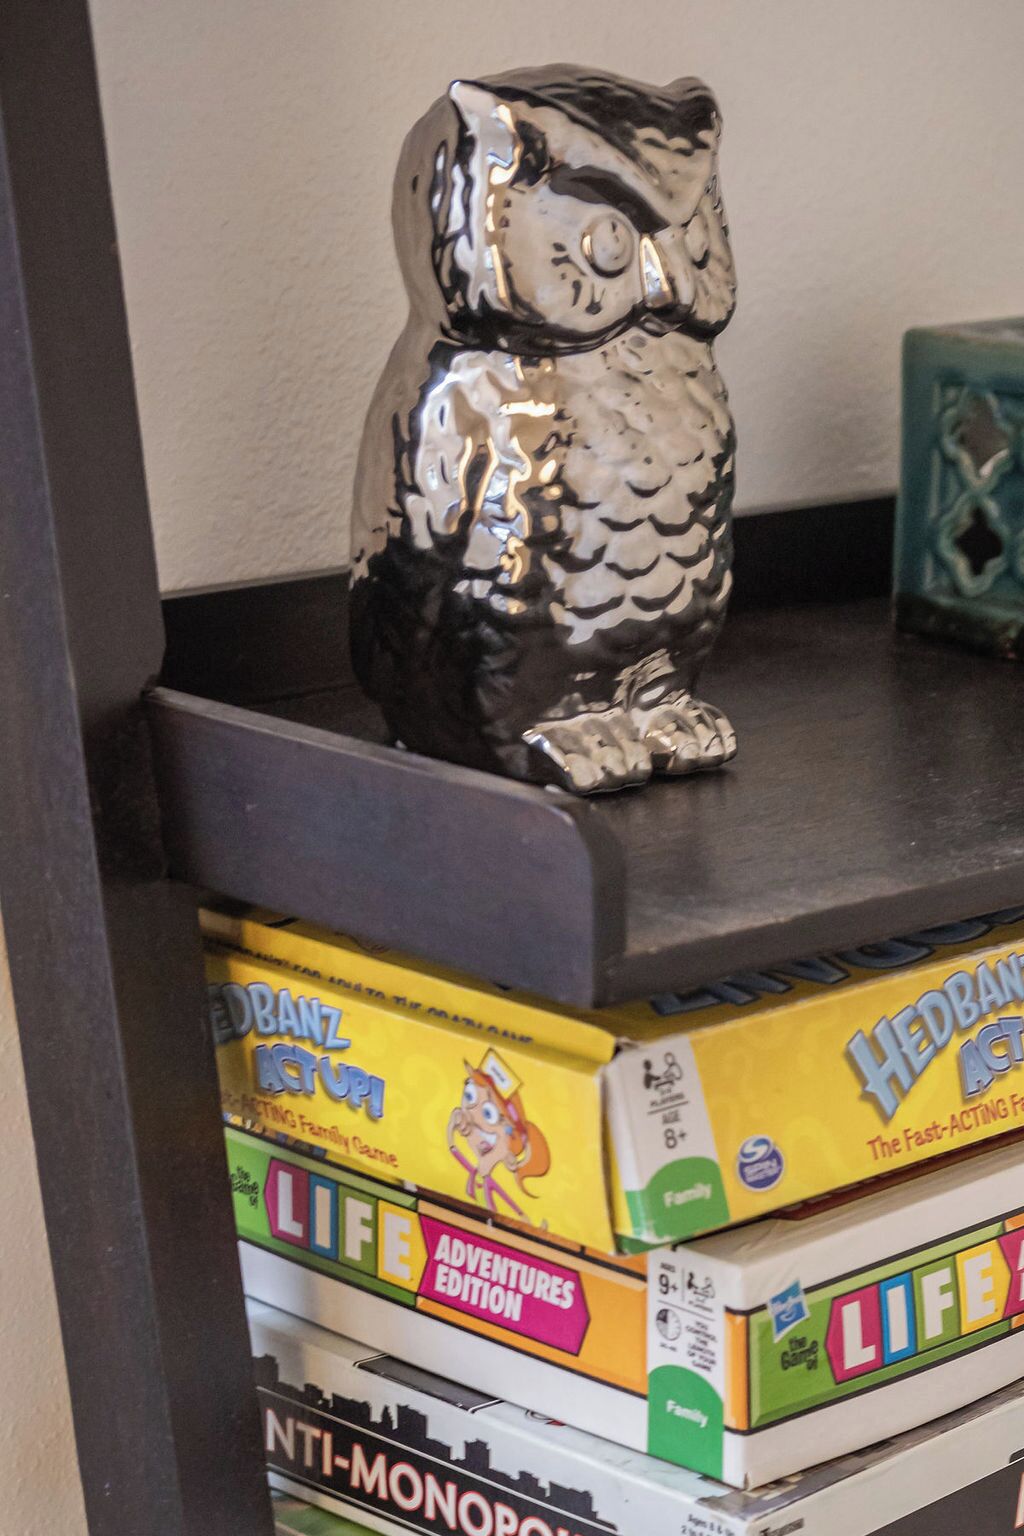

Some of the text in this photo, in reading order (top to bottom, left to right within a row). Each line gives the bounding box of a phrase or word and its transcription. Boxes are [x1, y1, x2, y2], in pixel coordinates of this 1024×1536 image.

[255, 1043, 318, 1095] ACT
[959, 1015, 1024, 1098] ACT
[299, 1114, 400, 1168] Family Game
[664, 1127, 688, 1149] 8+
[867, 1134, 902, 1161] The
[663, 1181, 713, 1209] Family
[276, 1168, 412, 1281] LIFE
[433, 1233, 575, 1310] ADVENTURES
[433, 1270, 523, 1323] EDITION
[658, 1273, 679, 1296] 9+
[841, 1249, 997, 1371] LIFE
[666, 1398, 709, 1429] Family
